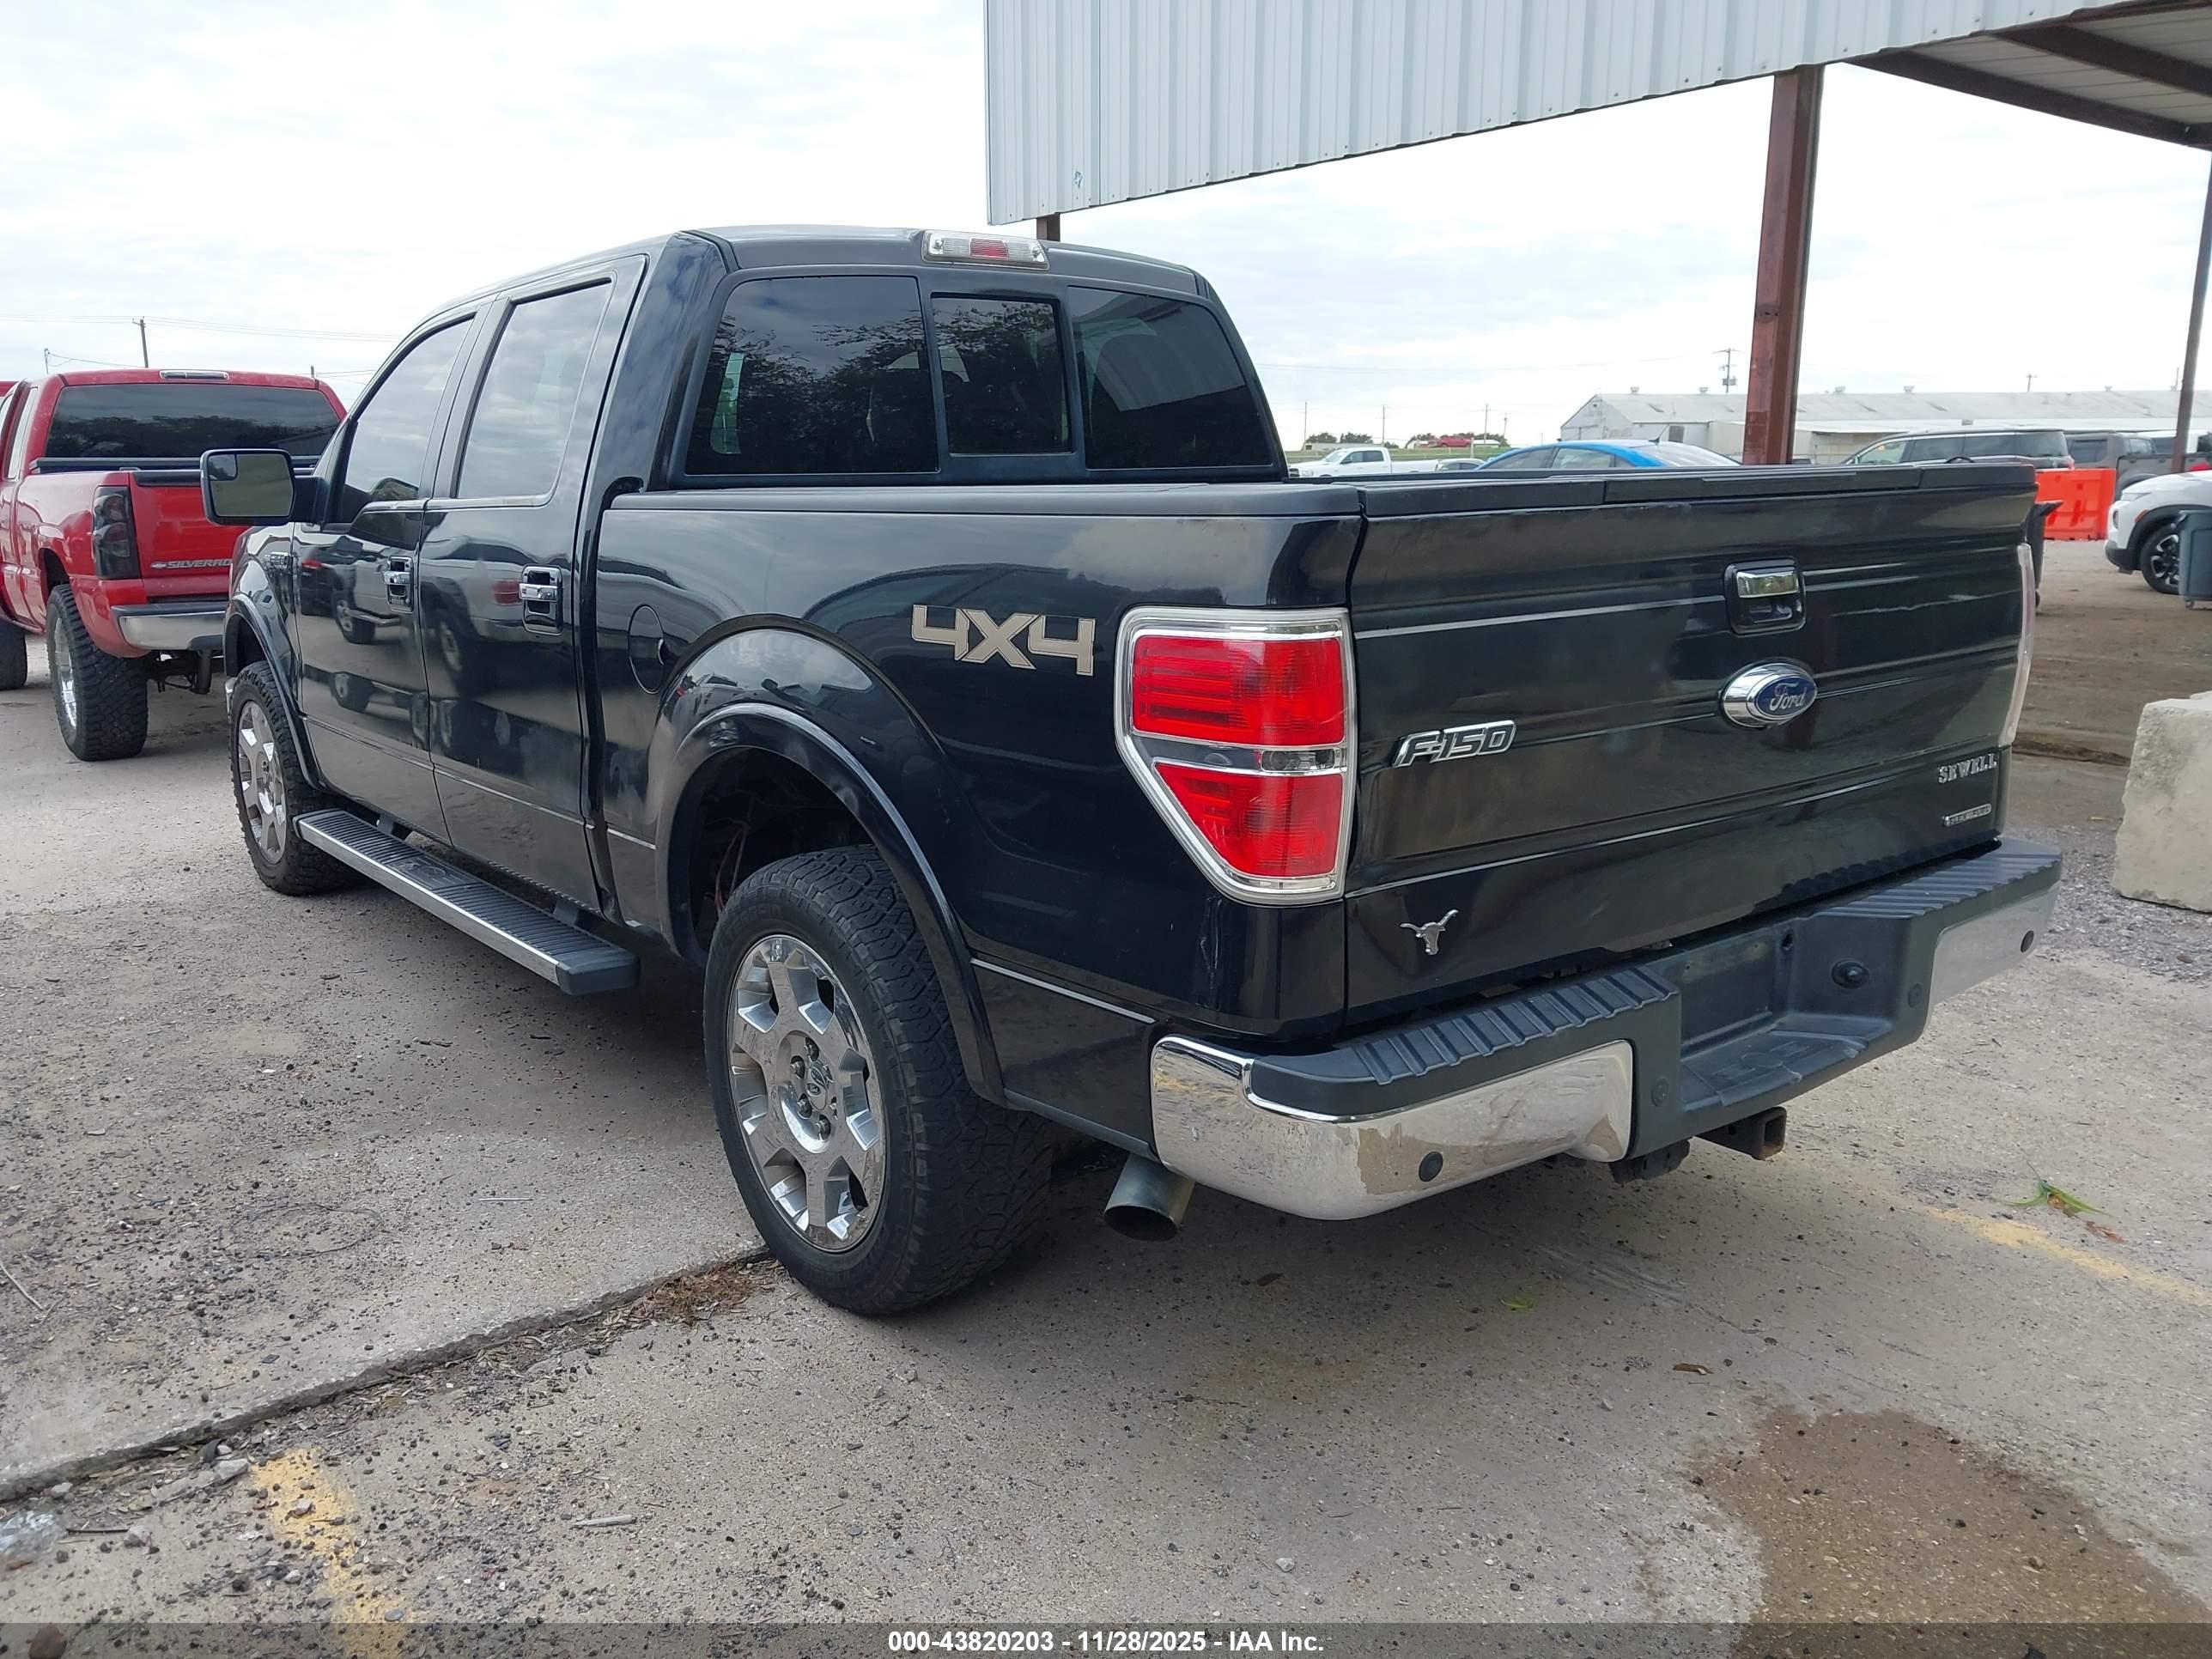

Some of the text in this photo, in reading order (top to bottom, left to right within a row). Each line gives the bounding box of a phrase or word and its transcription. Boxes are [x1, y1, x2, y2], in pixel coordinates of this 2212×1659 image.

[167, 558, 233, 569] SILVERAD
[1769, 682, 1808, 712] Ford
[1393, 720, 1516, 768] F-150
[1938, 752, 1997, 784] SEWELL
